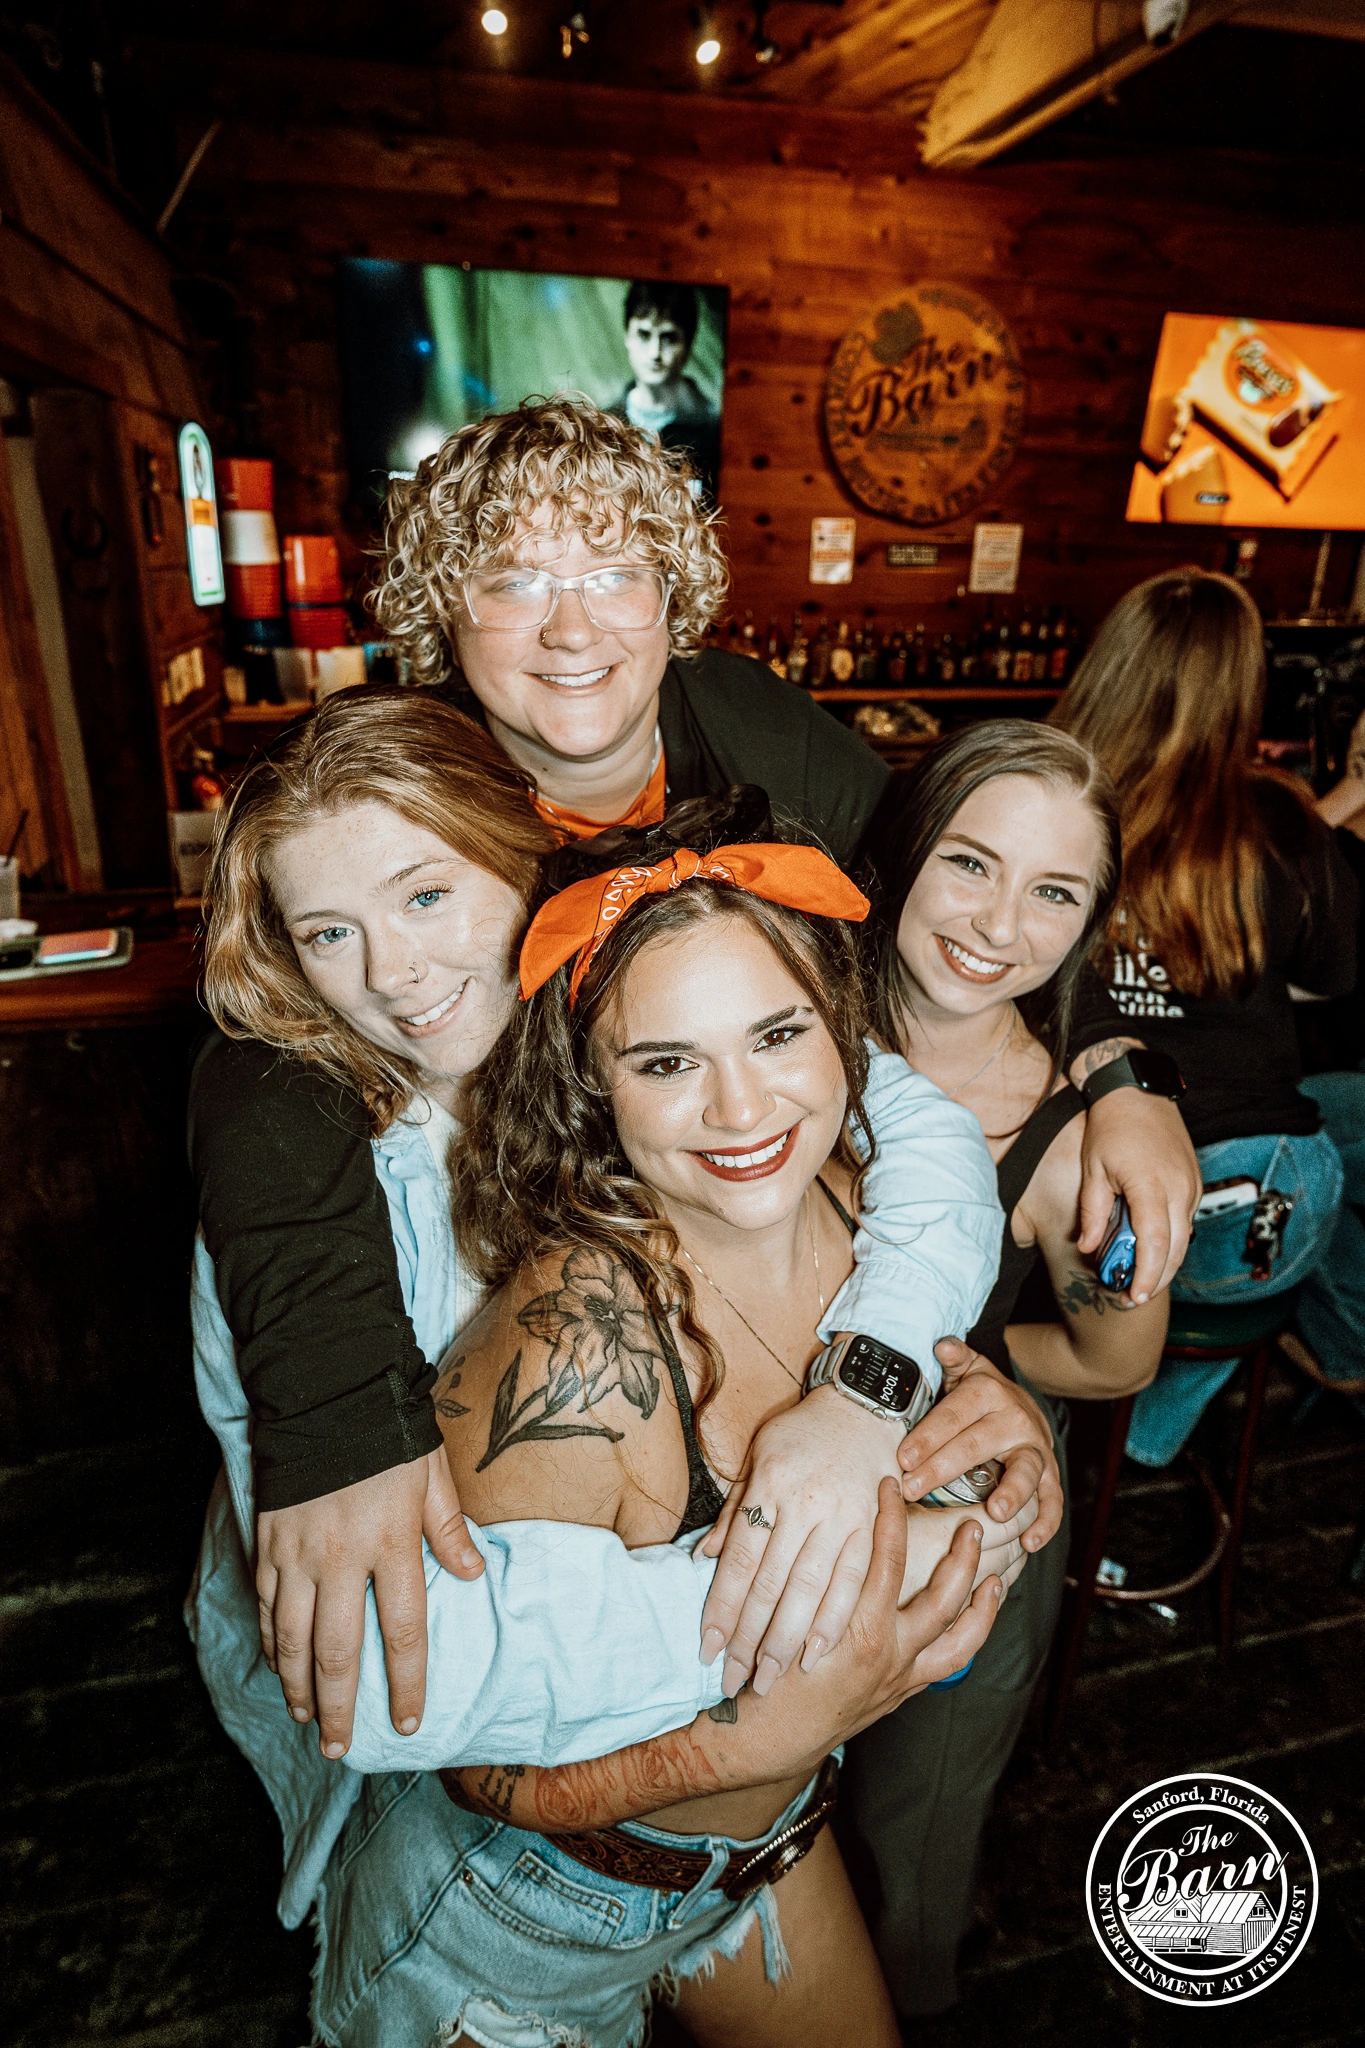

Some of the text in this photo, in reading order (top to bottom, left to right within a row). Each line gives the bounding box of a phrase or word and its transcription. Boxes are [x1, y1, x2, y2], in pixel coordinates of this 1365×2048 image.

[900, 335, 962, 386] The
[847, 352, 994, 437] Barn
[880, 1375, 899, 1402] 10:04
